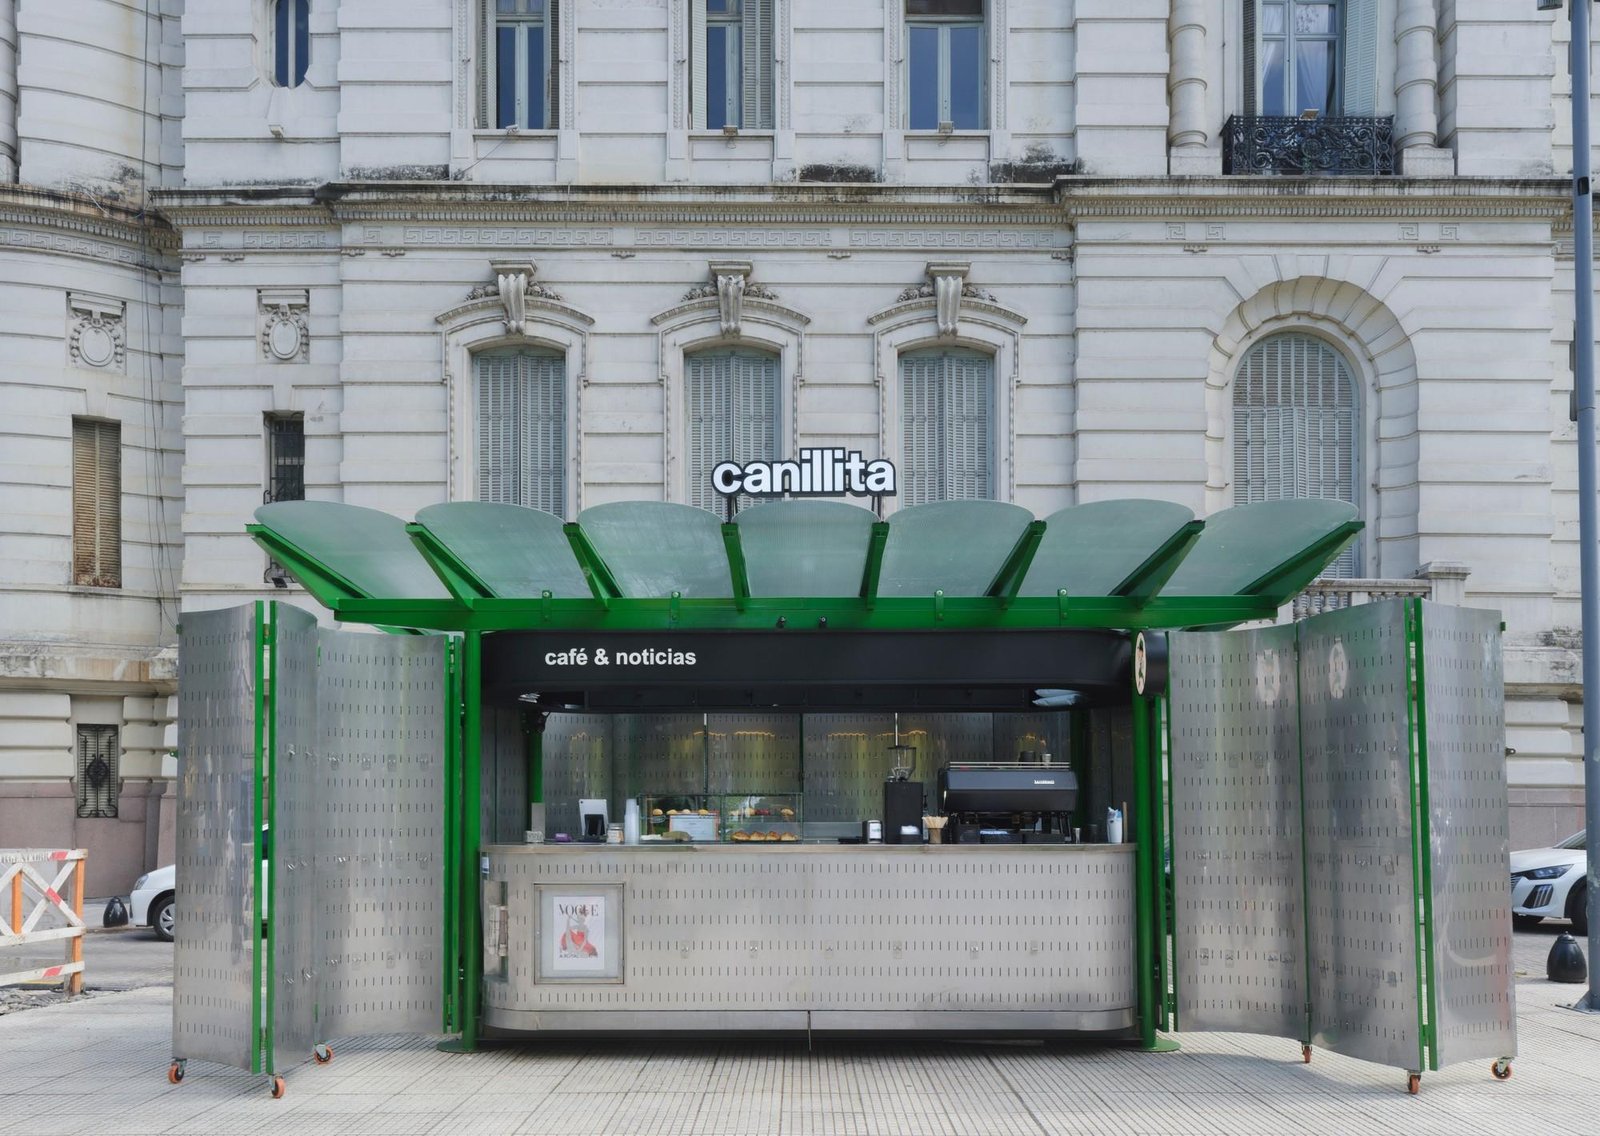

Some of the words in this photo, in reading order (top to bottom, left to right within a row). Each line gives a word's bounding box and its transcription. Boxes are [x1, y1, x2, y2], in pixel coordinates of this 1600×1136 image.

[712, 448, 896, 496] canillita
[544, 648, 588, 665] café
[594, 648, 610, 665] &
[616, 648, 697, 665] noticias
